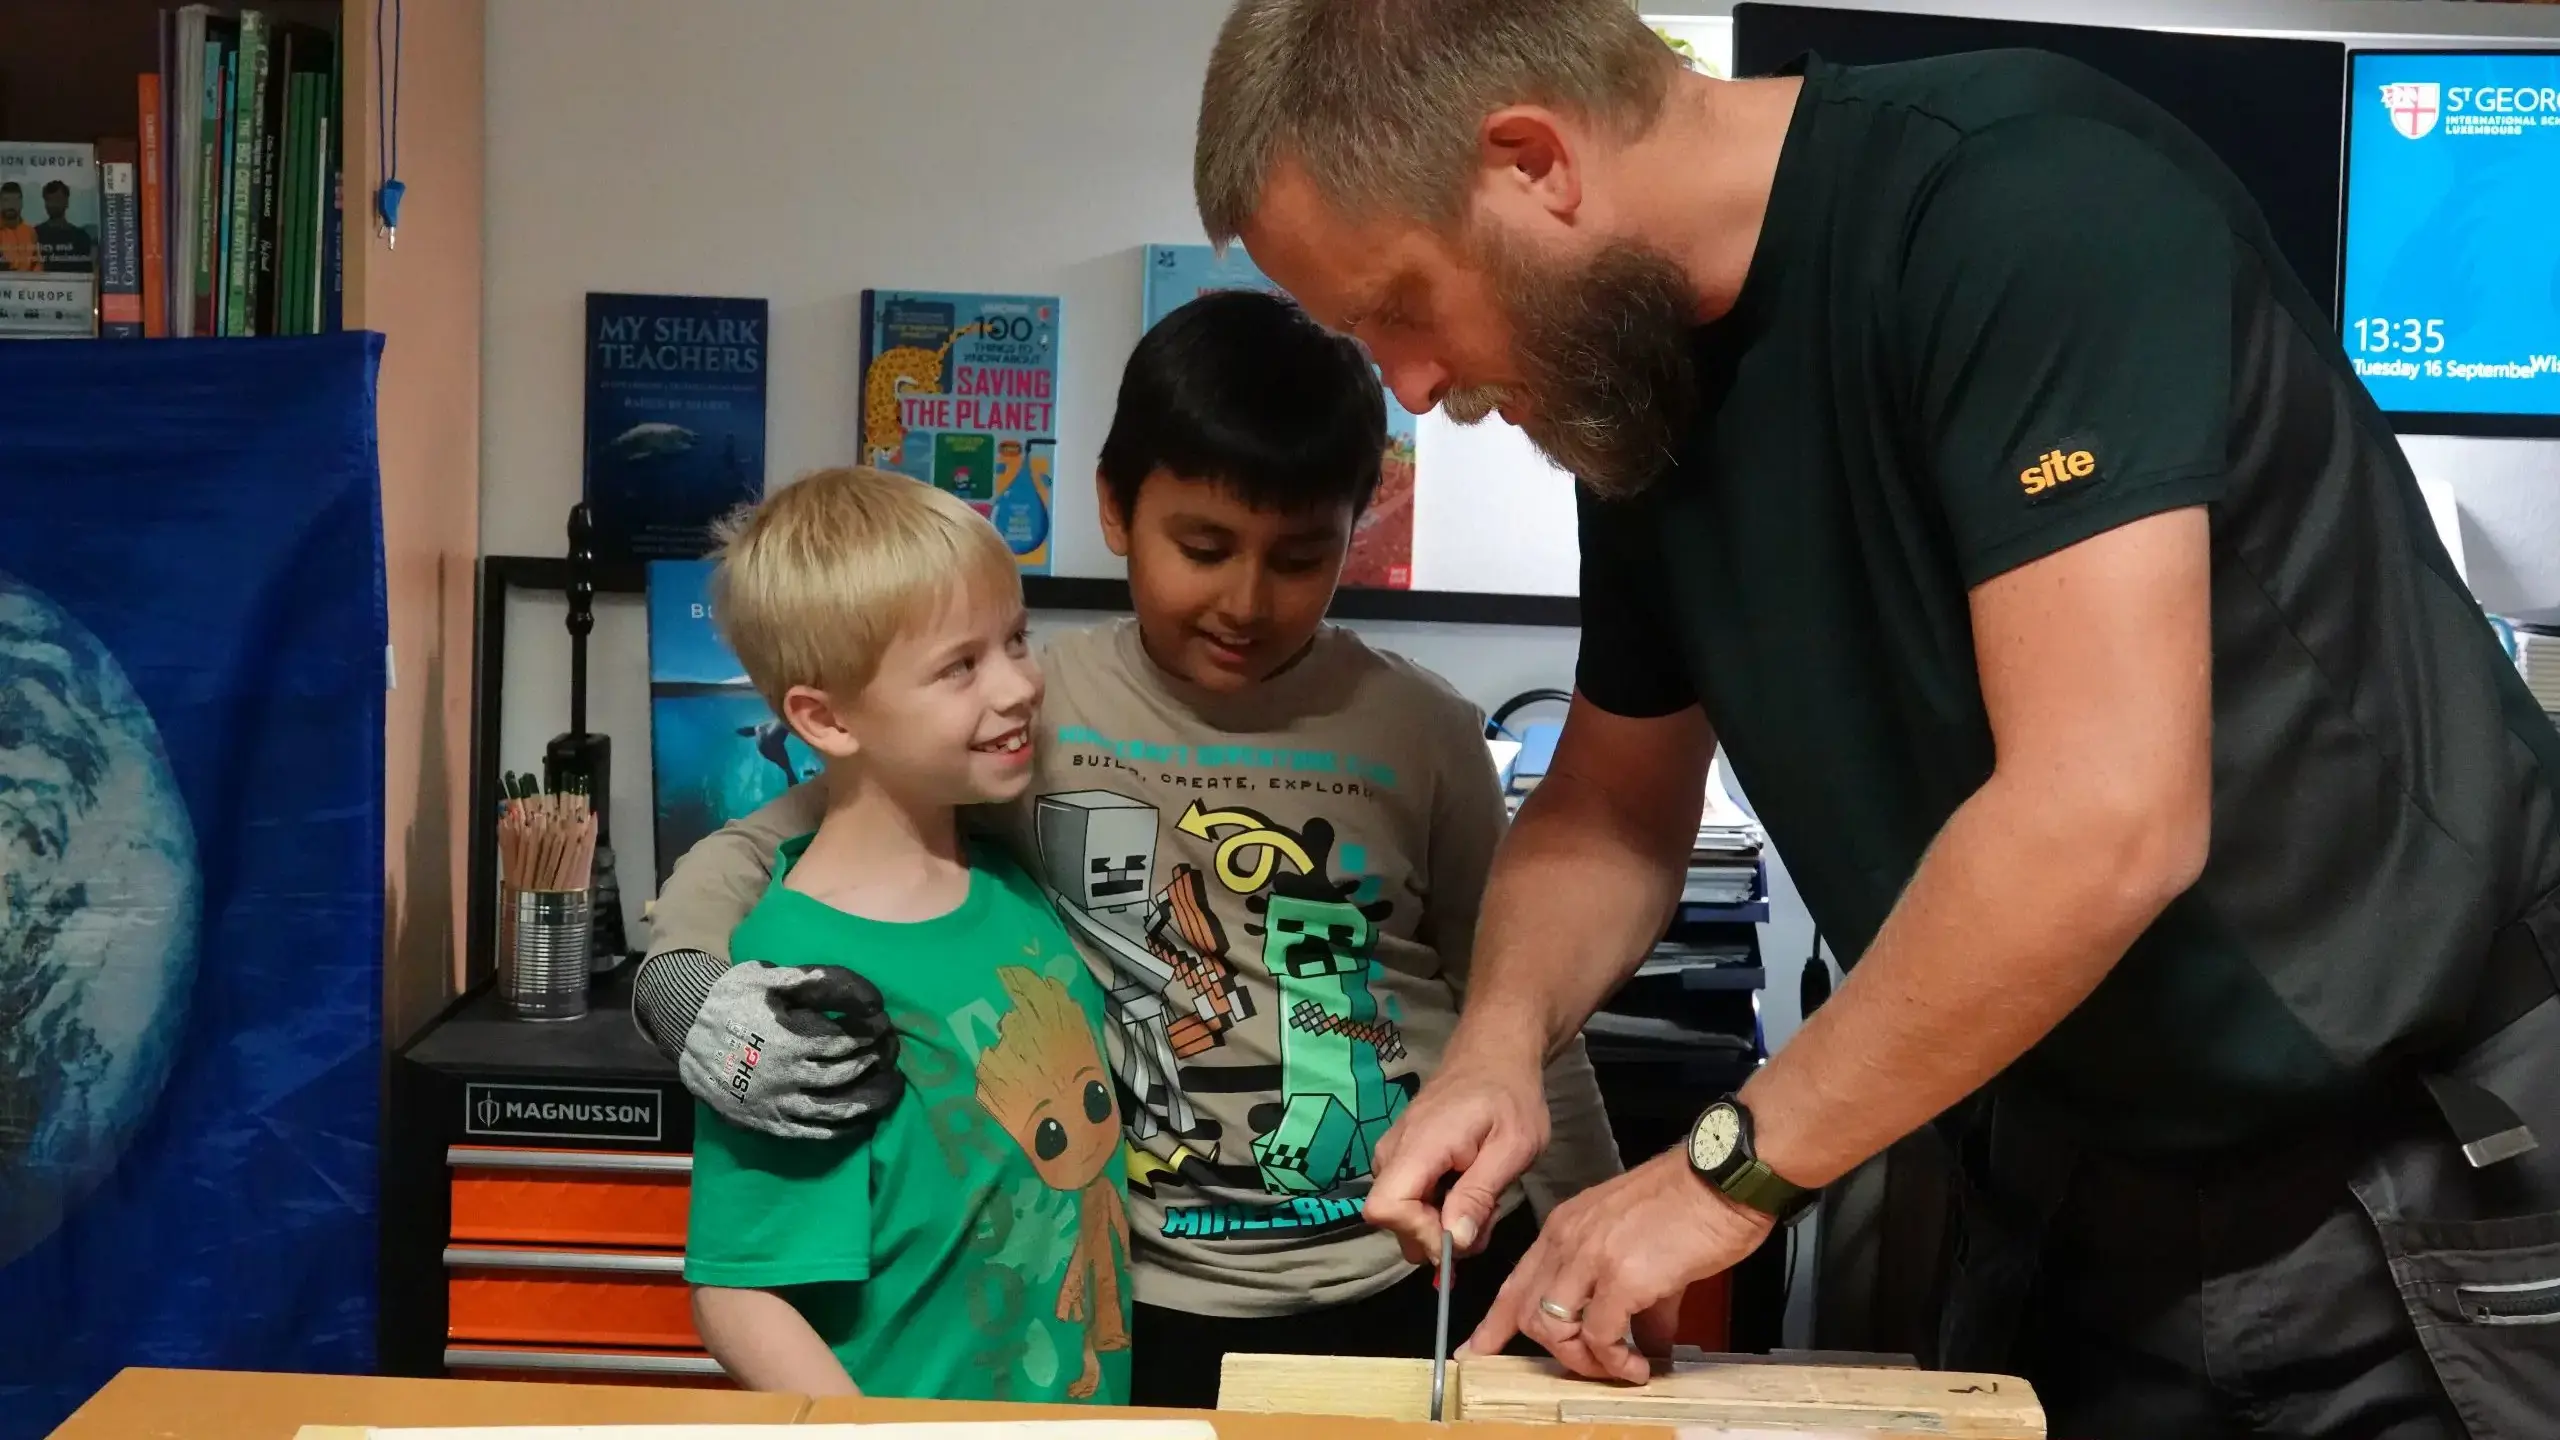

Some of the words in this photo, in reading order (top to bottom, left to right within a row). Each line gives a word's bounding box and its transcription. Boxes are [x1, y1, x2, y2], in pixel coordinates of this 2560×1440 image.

[2475, 87, 2560, 112] GEOR
[2445, 115, 2536, 126] INTERNATIONAL
[2445, 125, 2522, 136] LUXEMBOURG
[30, 156, 84, 167] EUROPE
[18, 291, 74, 301] EUROPE
[599, 316, 648, 342] MY
[654, 317, 760, 345] SHARK
[974, 315, 1034, 342] 100
[2354, 317, 2445, 353] 13:35
[598, 343, 759, 373] TEACHERS
[2353, 359, 2420, 380] Tuesday
[2424, 360, 2443, 377] 16
[2446, 360, 2535, 381] September
[957, 366, 1051, 398] SAVING
[902, 399, 950, 428] THE
[956, 400, 1053, 432] PLANET
[2020, 449, 2095, 495] site
[1161, 773, 1256, 790] CREATE,
[506, 1102, 650, 1123] MAGNUSSON
